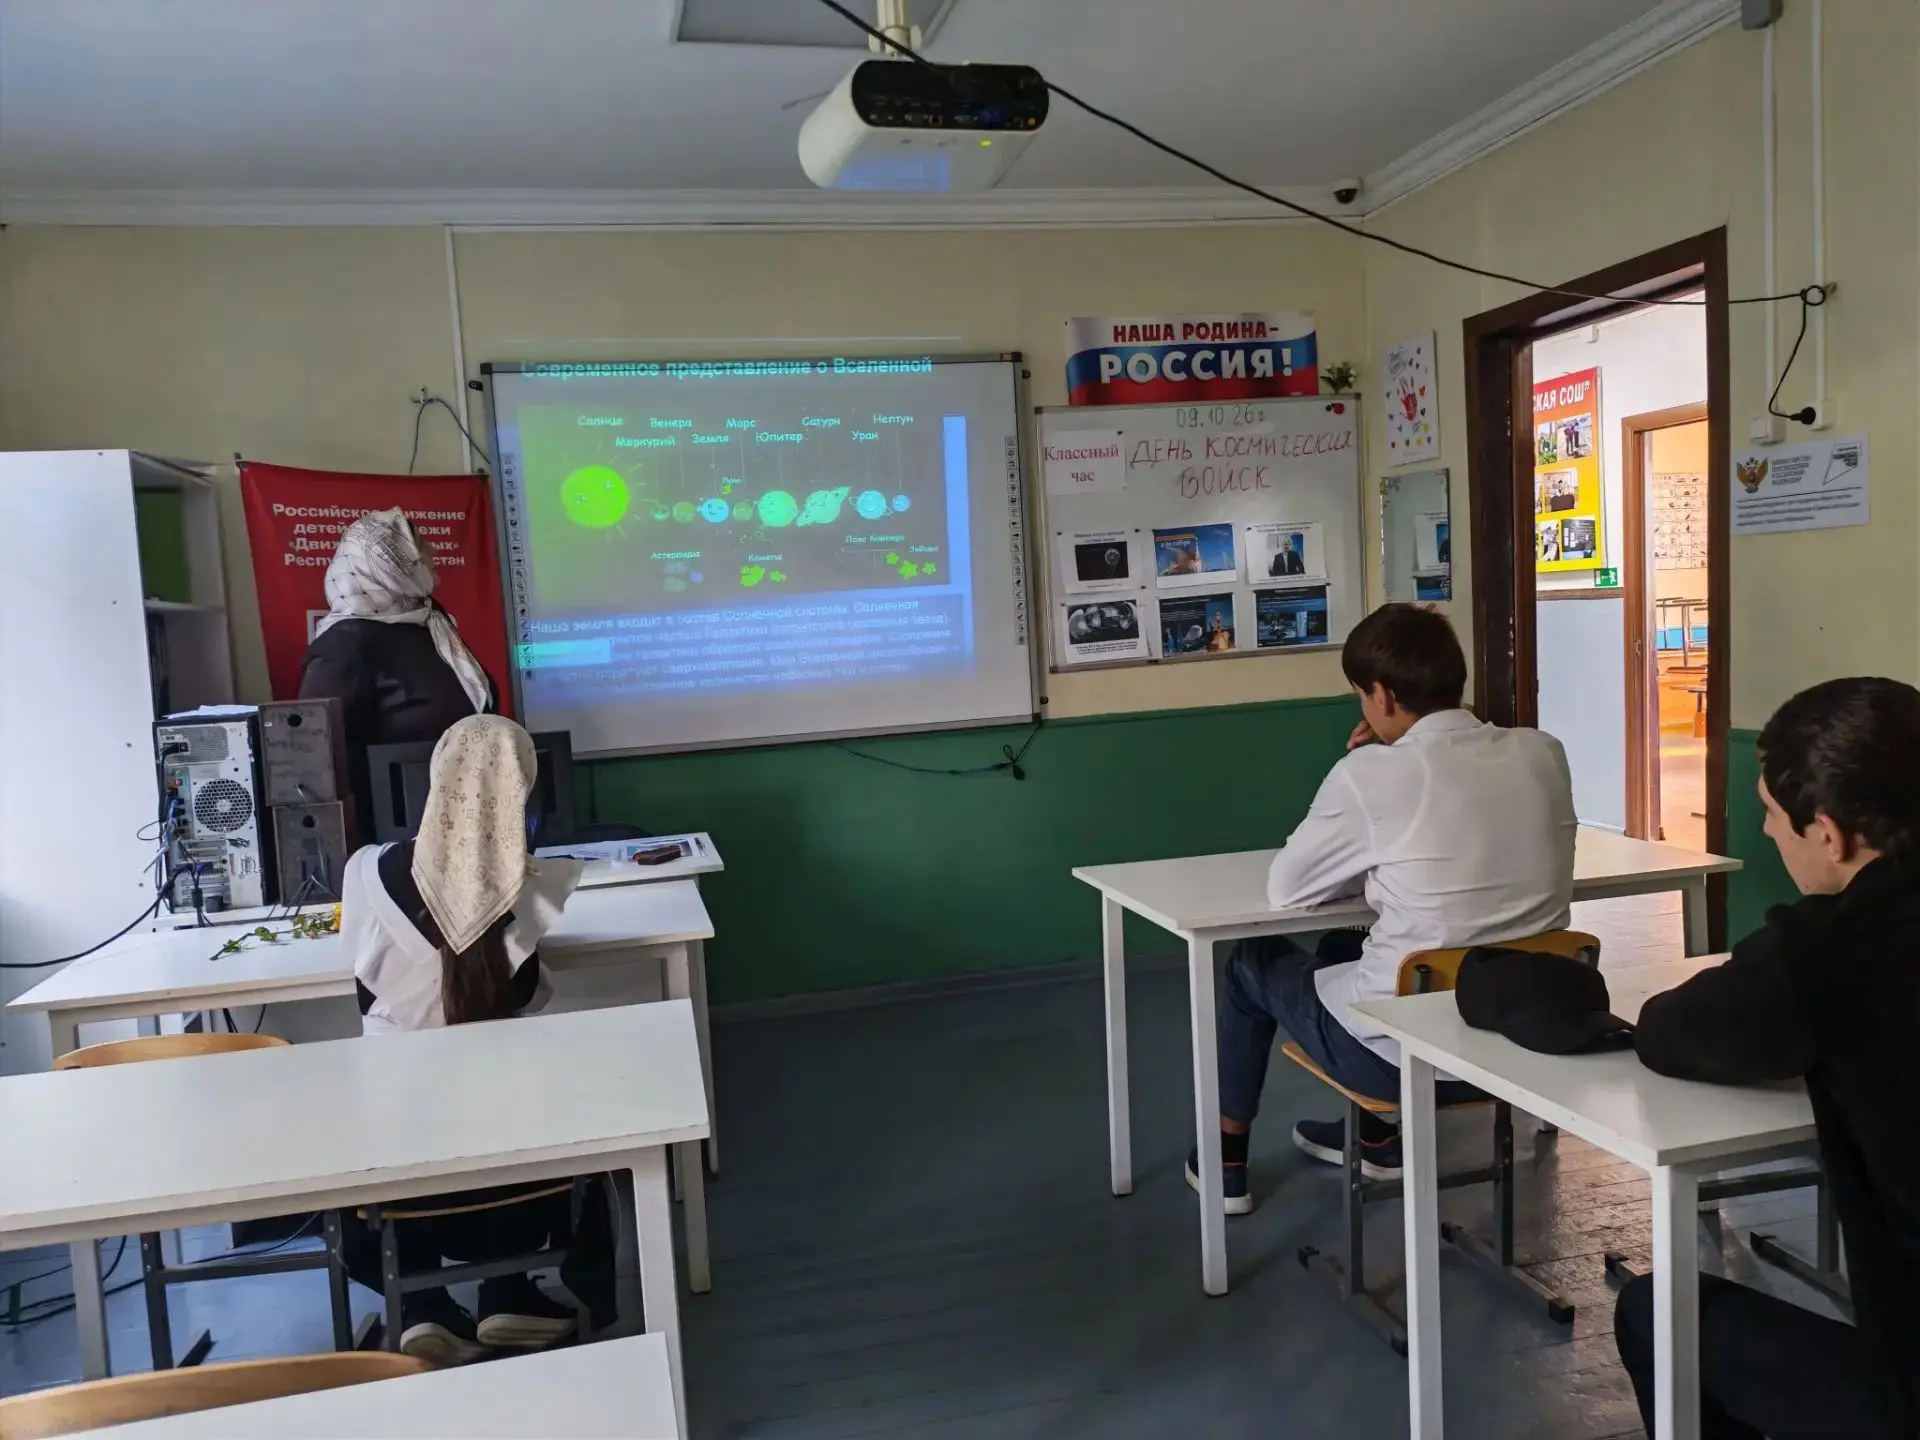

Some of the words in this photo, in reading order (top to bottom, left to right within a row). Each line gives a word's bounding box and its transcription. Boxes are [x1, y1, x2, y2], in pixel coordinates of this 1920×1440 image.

[1113, 324, 1175, 343] НАША
[521, 362, 659, 380] Современное
[666, 360, 812, 379] представление
[816, 364, 828, 375] о
[833, 356, 932, 374] Вселенной
[1100, 348, 1292, 384] РОССИЯ!
[577, 415, 625, 427] Солнце
[649, 417, 692, 430] Венера
[725, 417, 757, 431] Марс
[801, 416, 841, 428] Сатурн
[872, 413, 914, 425] Нептун
[615, 435, 677, 449] Меркурий
[692, 433, 730, 444] Земля
[755, 431, 804, 443] Юпитер
[850, 430, 878, 442] Уран
[1044, 444, 1120, 461] Классный
[1130, 439, 1193, 469] ДЕНЬ
[1071, 471, 1096, 482] час
[404, 510, 466, 521] ижение
